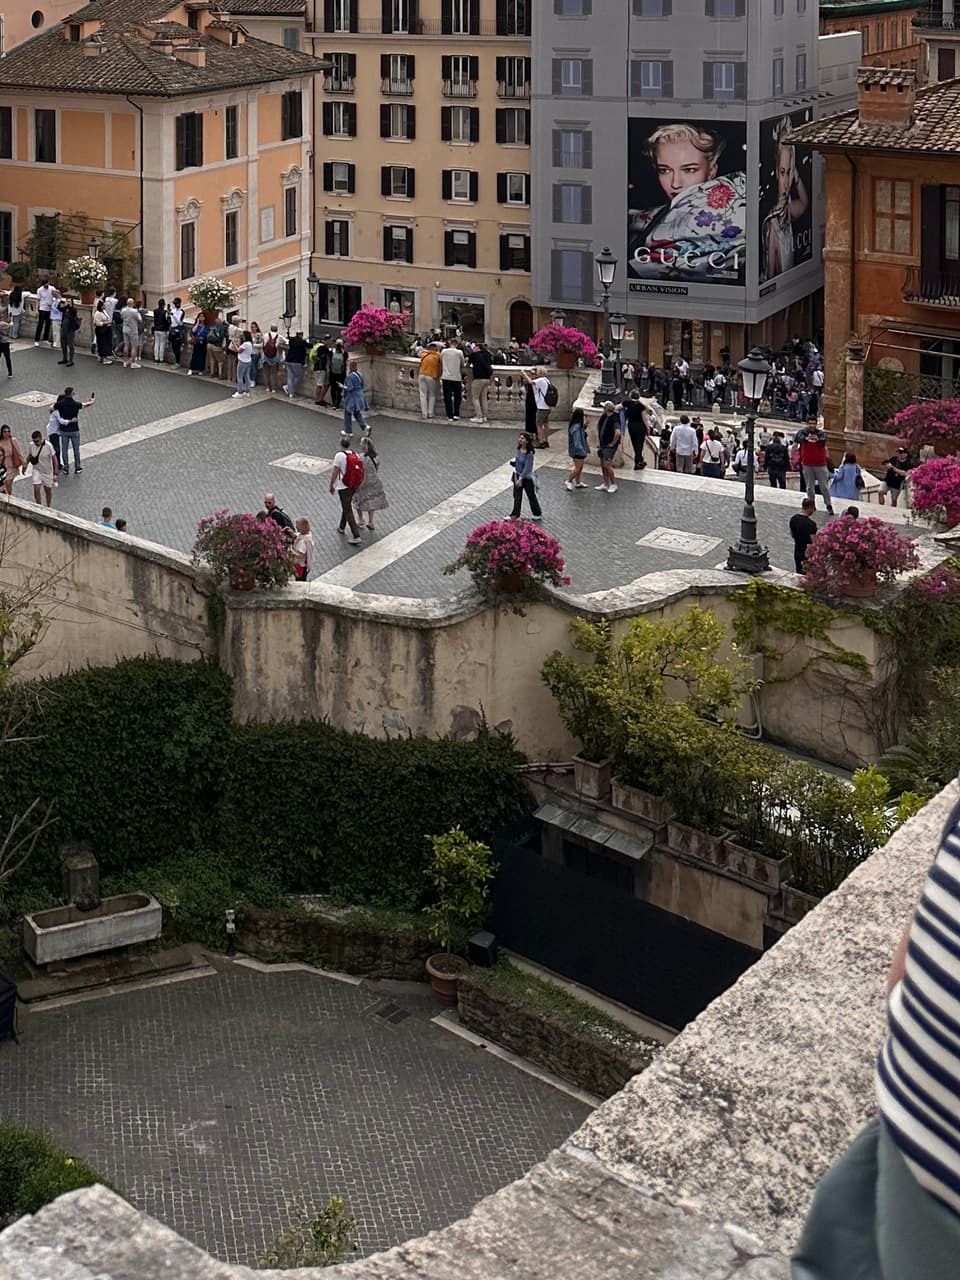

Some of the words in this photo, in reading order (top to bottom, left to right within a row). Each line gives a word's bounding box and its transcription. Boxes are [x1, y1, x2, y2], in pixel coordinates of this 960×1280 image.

[633, 246, 739, 270] GUCCI
[630, 284, 658, 292] URBAN
[660, 286, 687, 294] VISION
